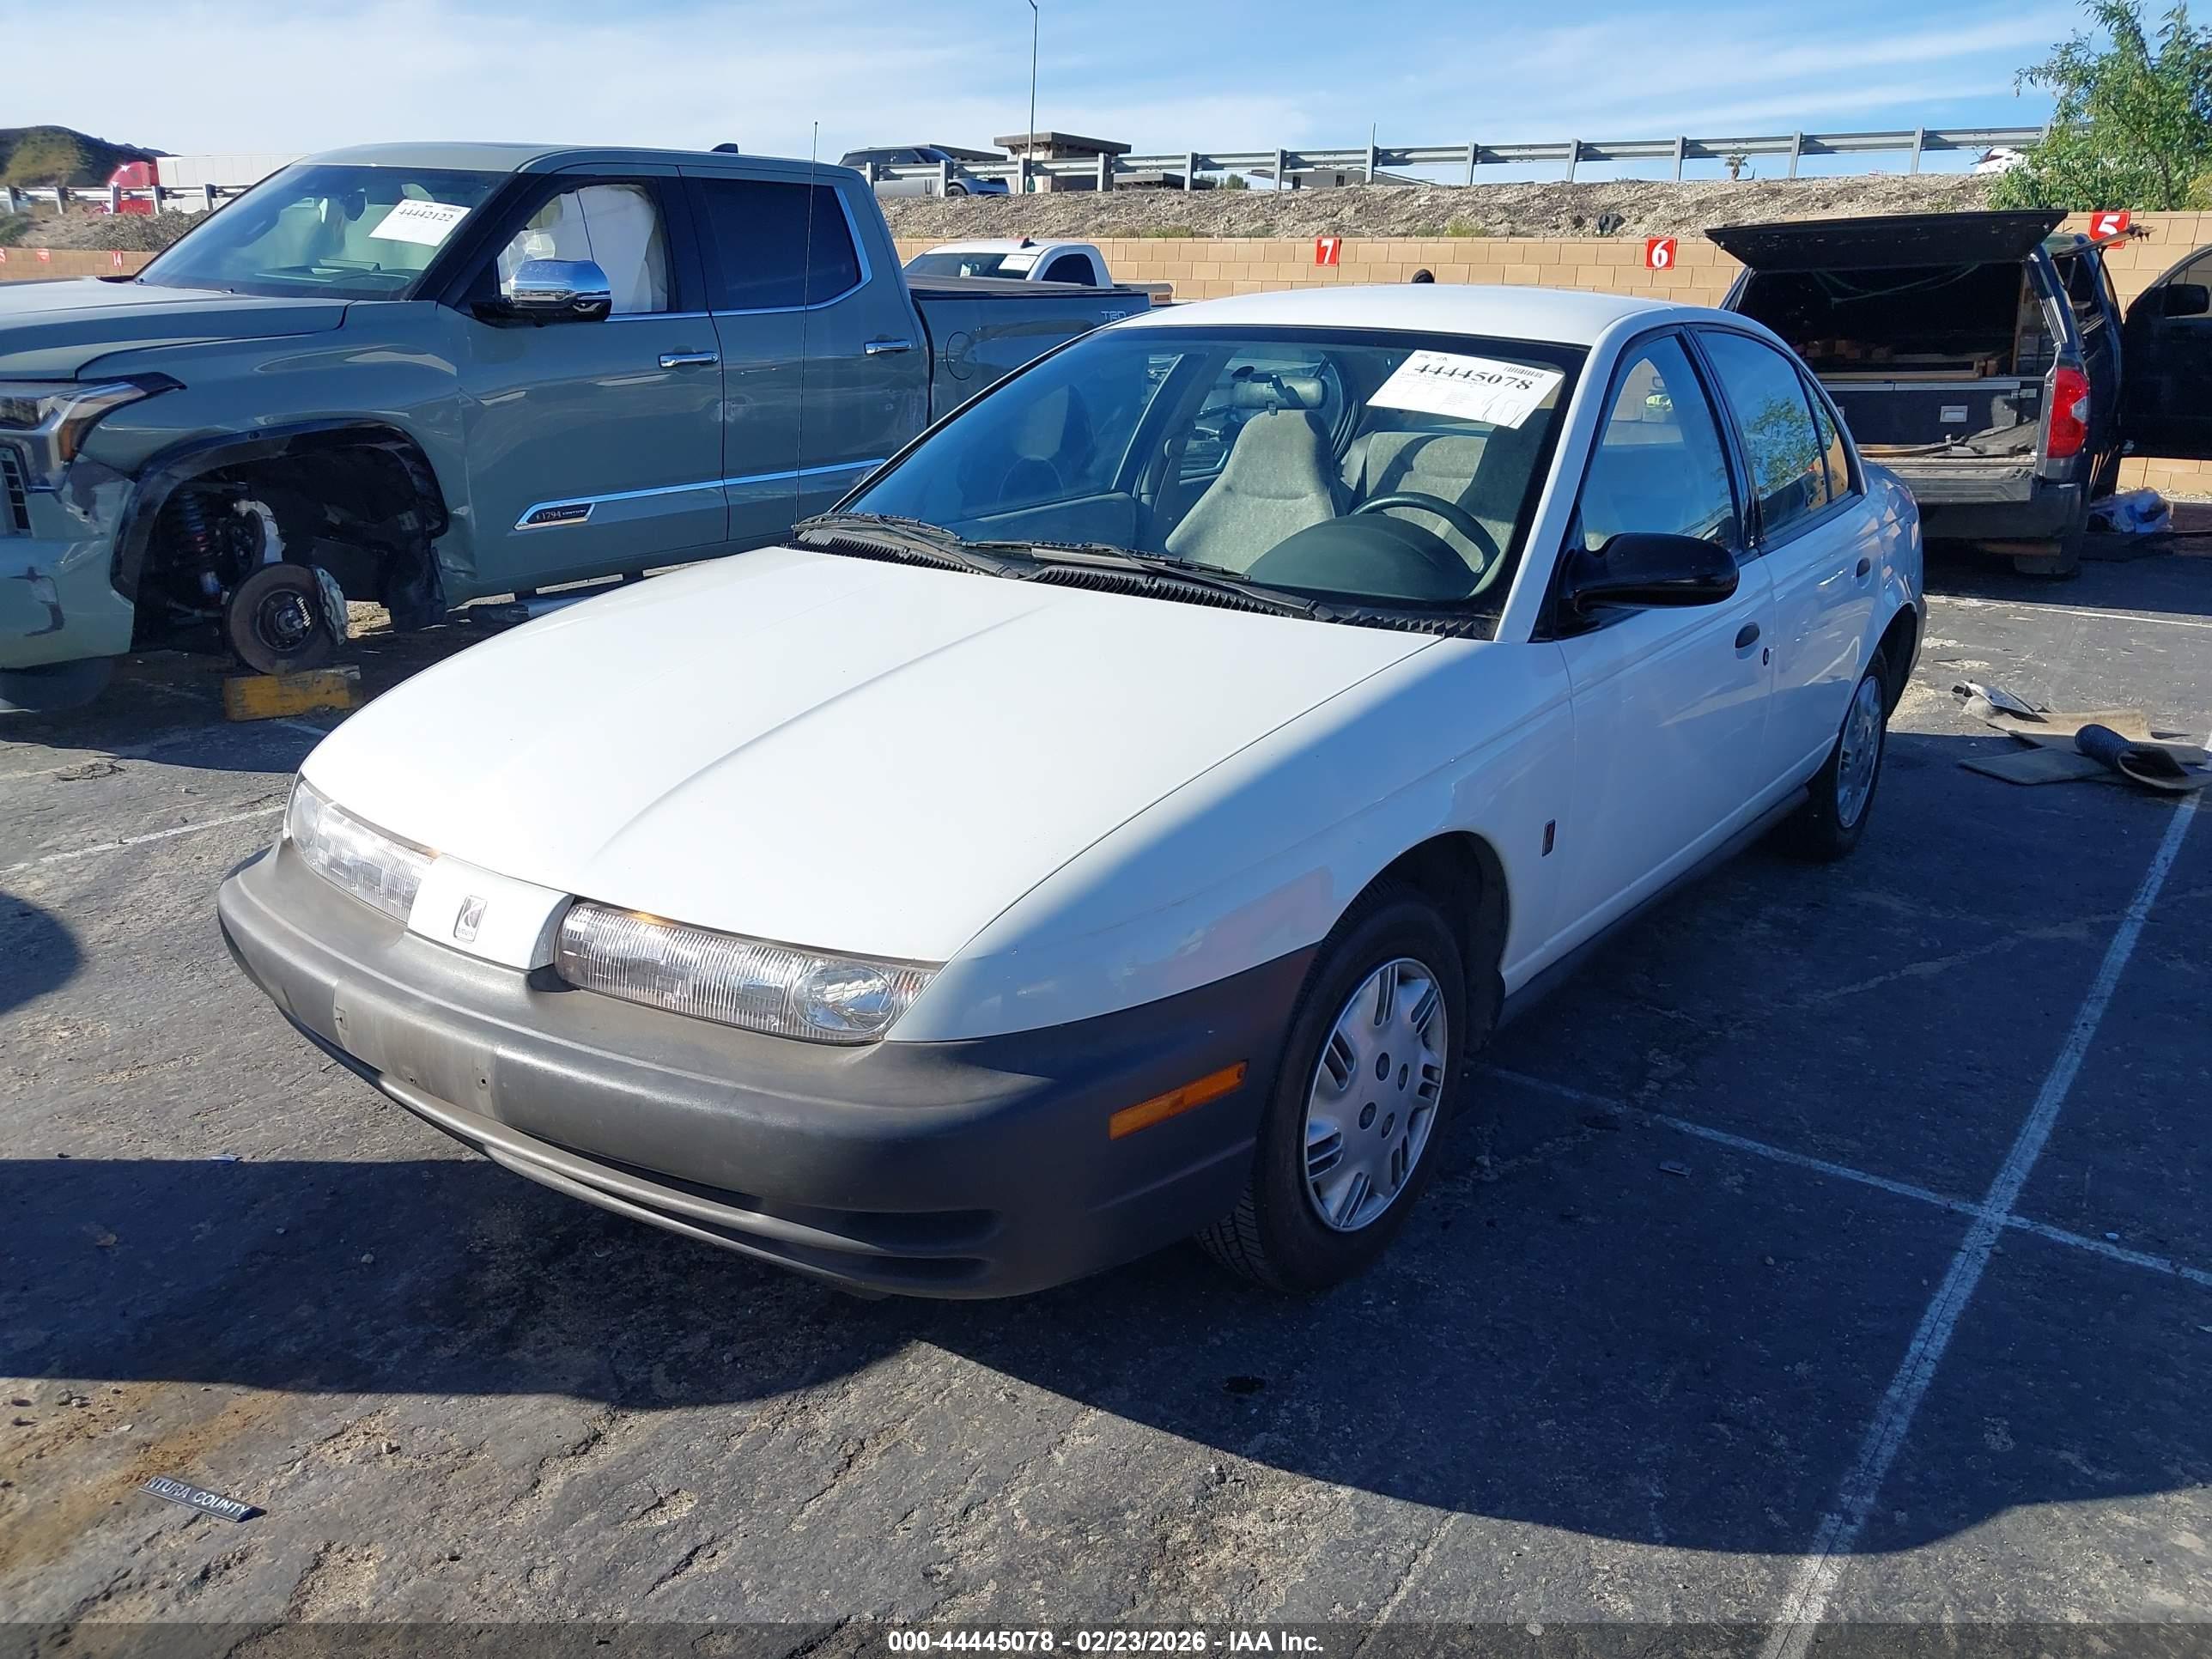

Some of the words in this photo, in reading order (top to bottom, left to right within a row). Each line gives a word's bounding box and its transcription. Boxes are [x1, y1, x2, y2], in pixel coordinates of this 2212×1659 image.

[398, 208, 454, 222] 44442122
[2098, 215, 2121, 235] 5
[1321, 239, 1334, 264] 7
[1651, 240, 1670, 268] 6
[1414, 363, 1534, 391] 44445078
[542, 510, 562, 520] 1794
[145, 1476, 192, 1498] NTURA
[193, 1491, 252, 1516] COUNTY
